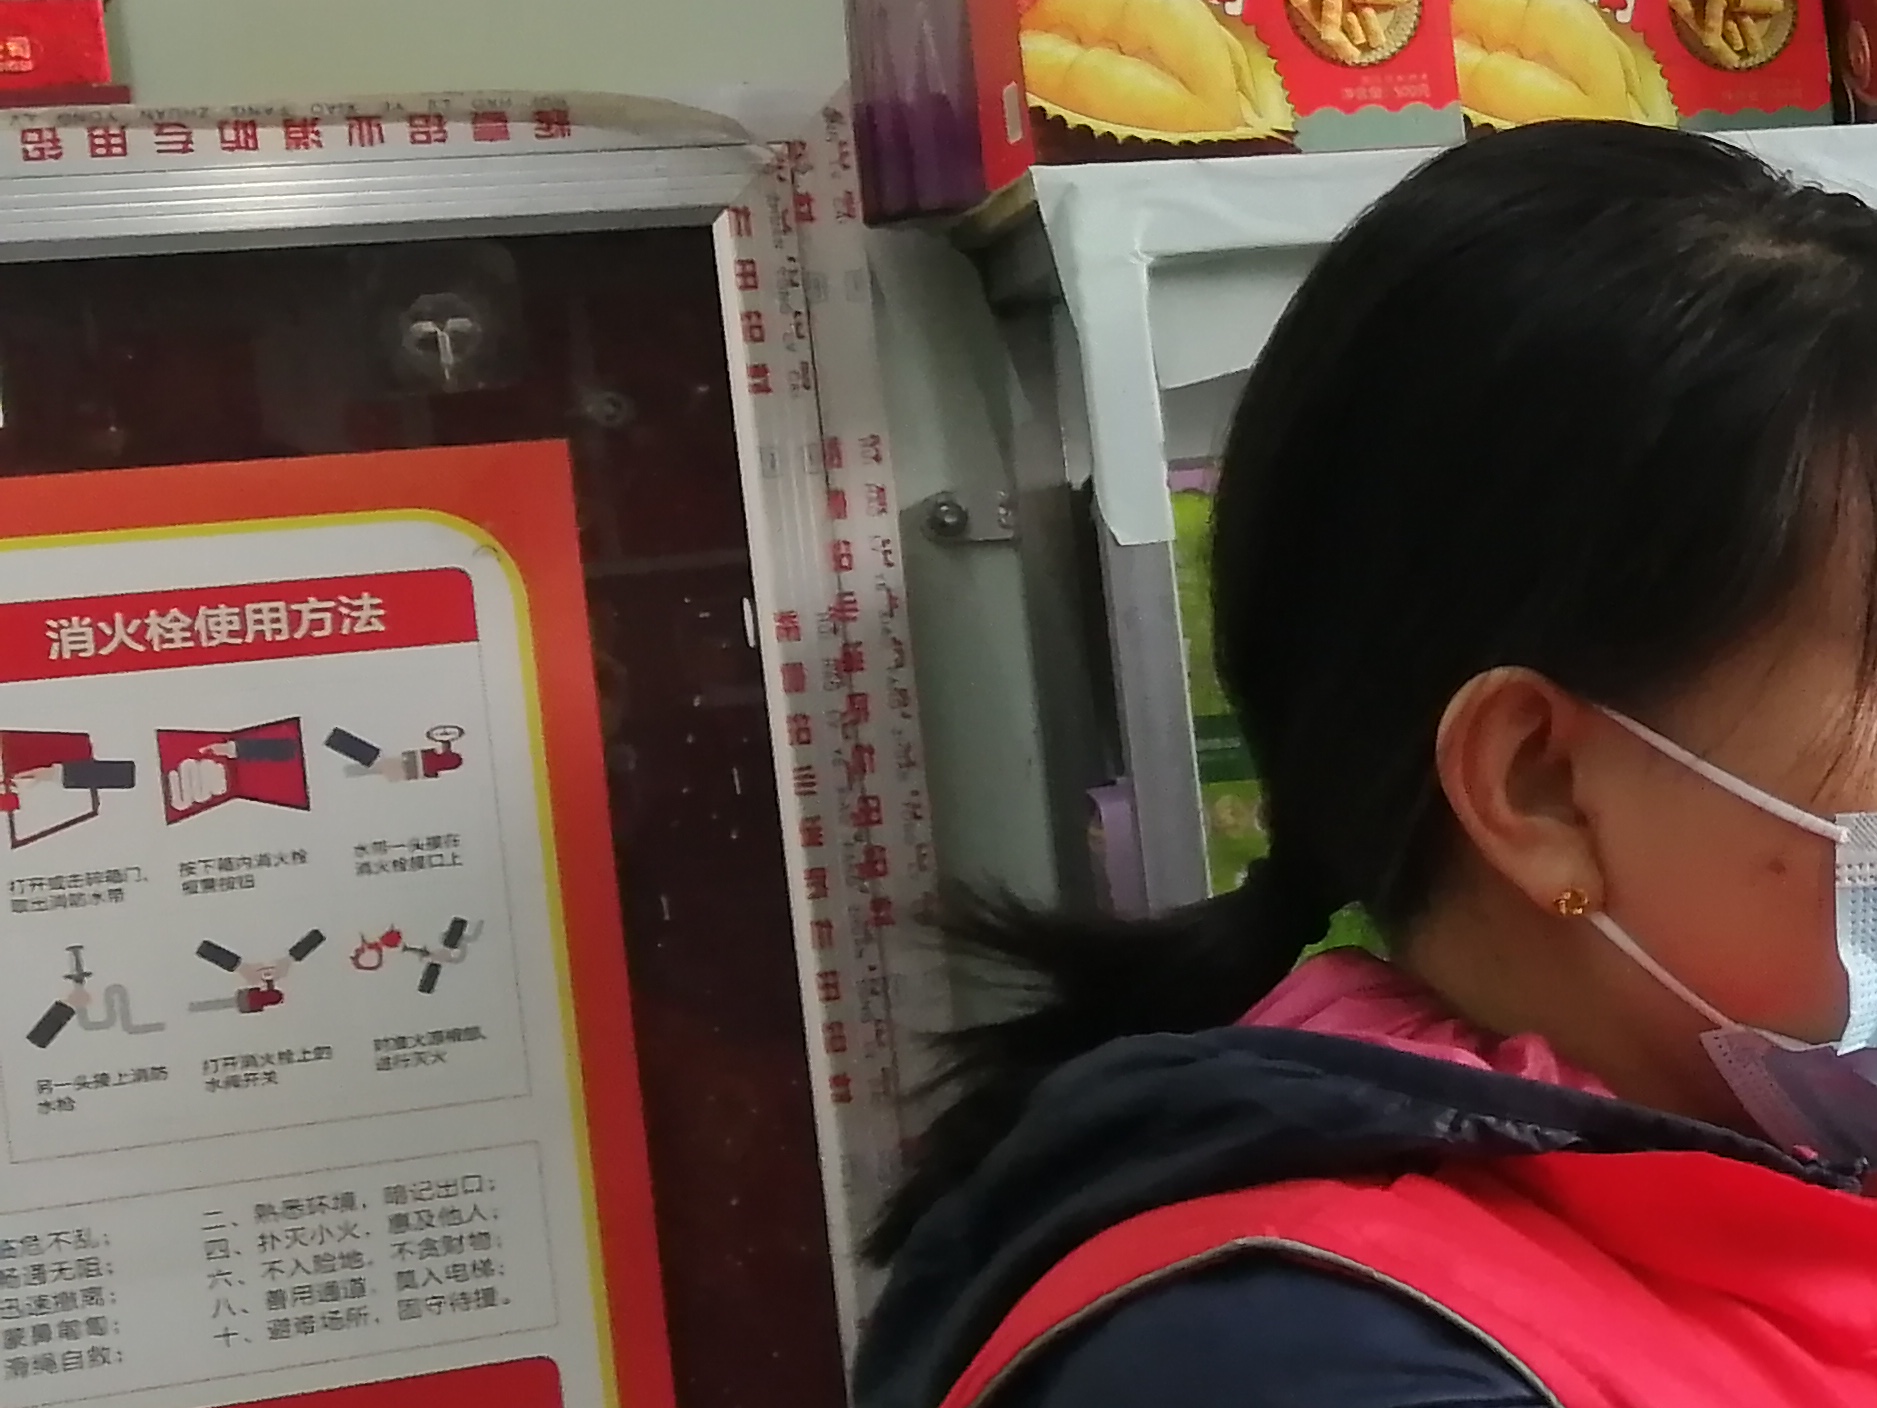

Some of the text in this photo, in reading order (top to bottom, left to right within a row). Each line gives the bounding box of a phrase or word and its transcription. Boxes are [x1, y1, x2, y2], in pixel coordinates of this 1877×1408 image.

[44, 591, 388, 662] 消火栓使用方法
